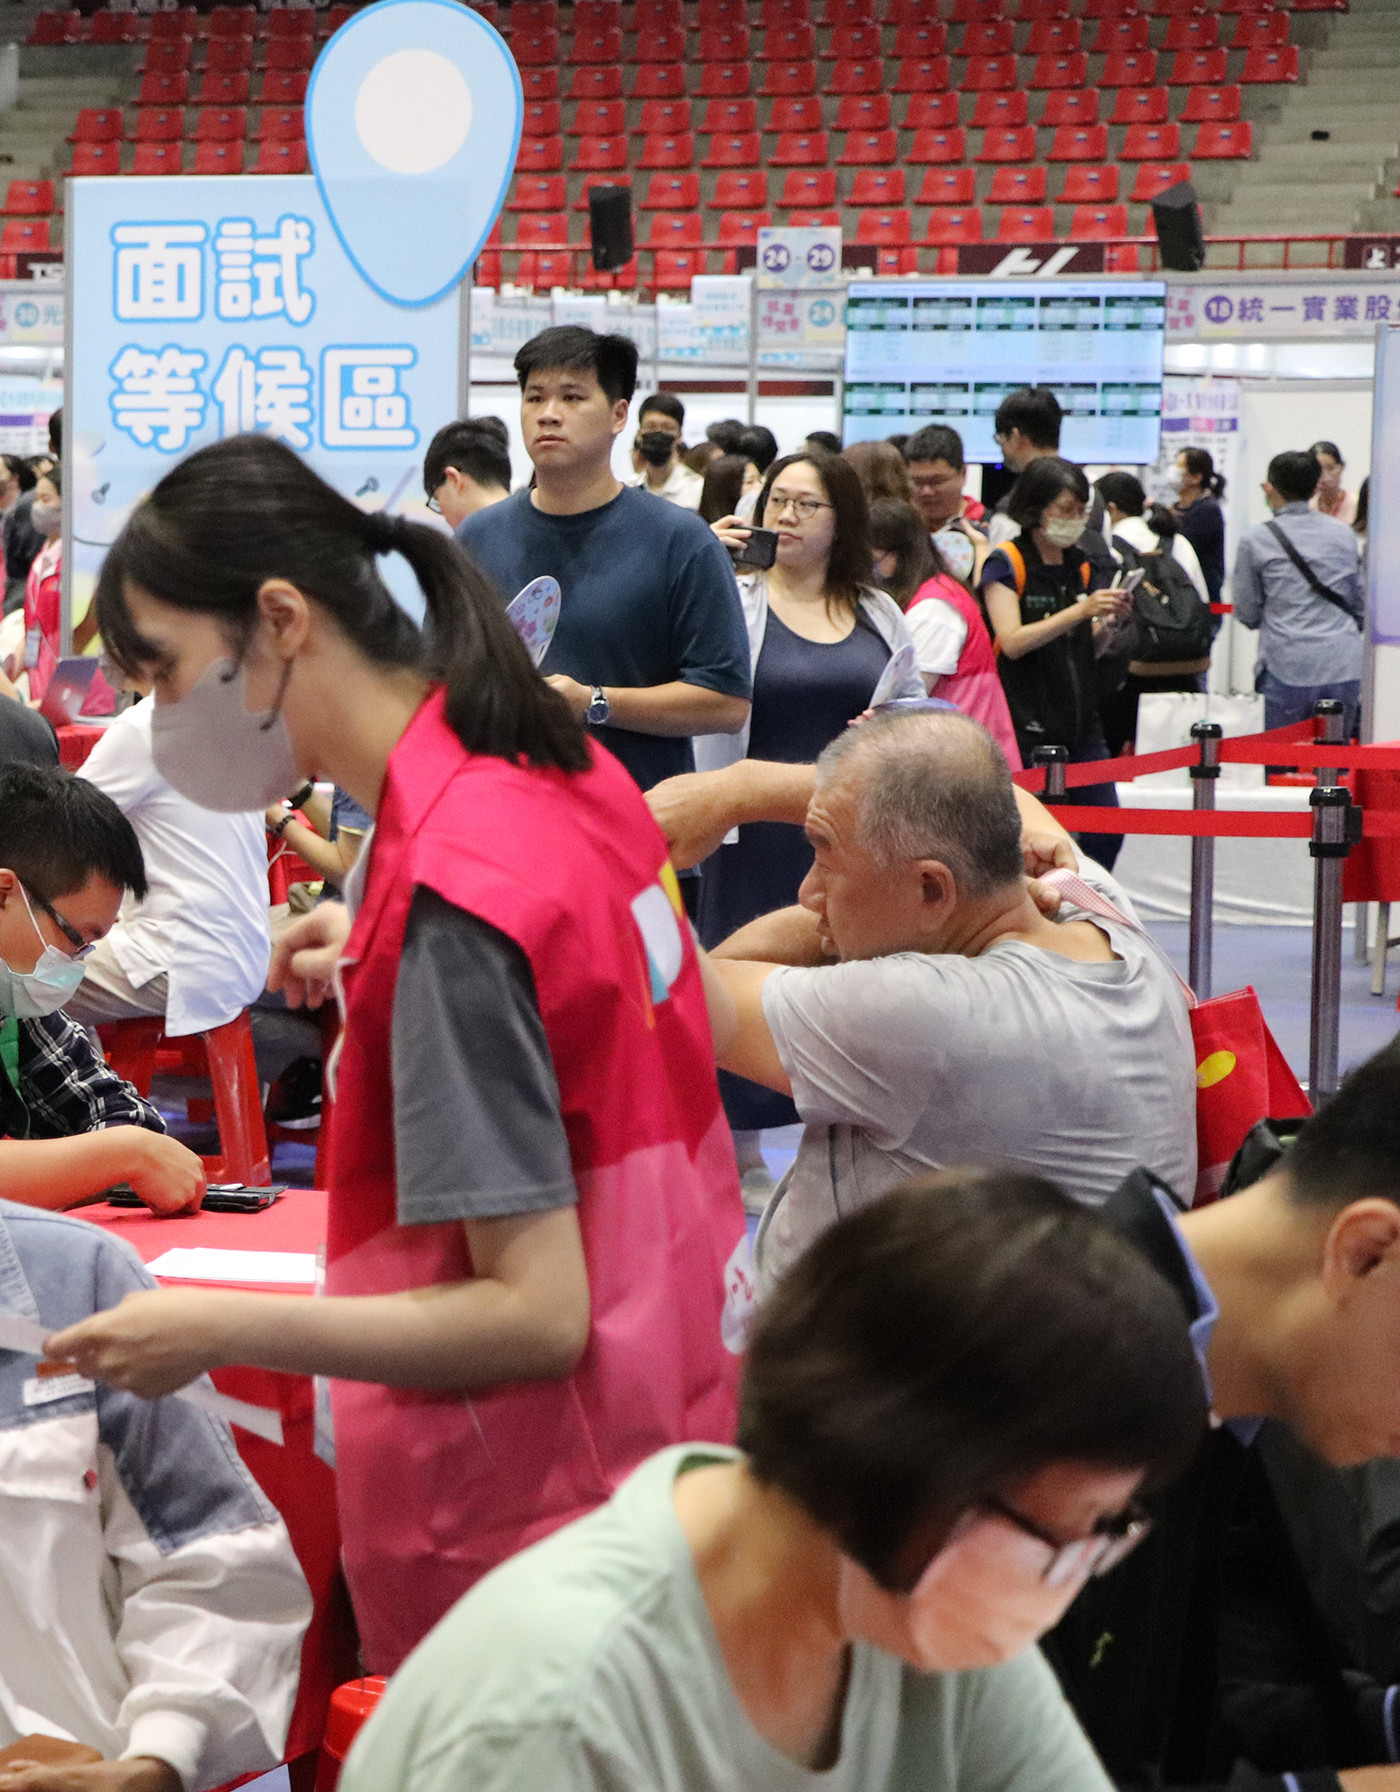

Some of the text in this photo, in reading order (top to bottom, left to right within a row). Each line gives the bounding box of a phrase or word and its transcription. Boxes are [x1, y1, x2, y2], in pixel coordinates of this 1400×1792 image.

[111, 214, 313, 326] 面試
[765, 248, 789, 268] 24
[1238, 294, 1400, 322] 統一實業股
[111, 344, 419, 453] 等候區
